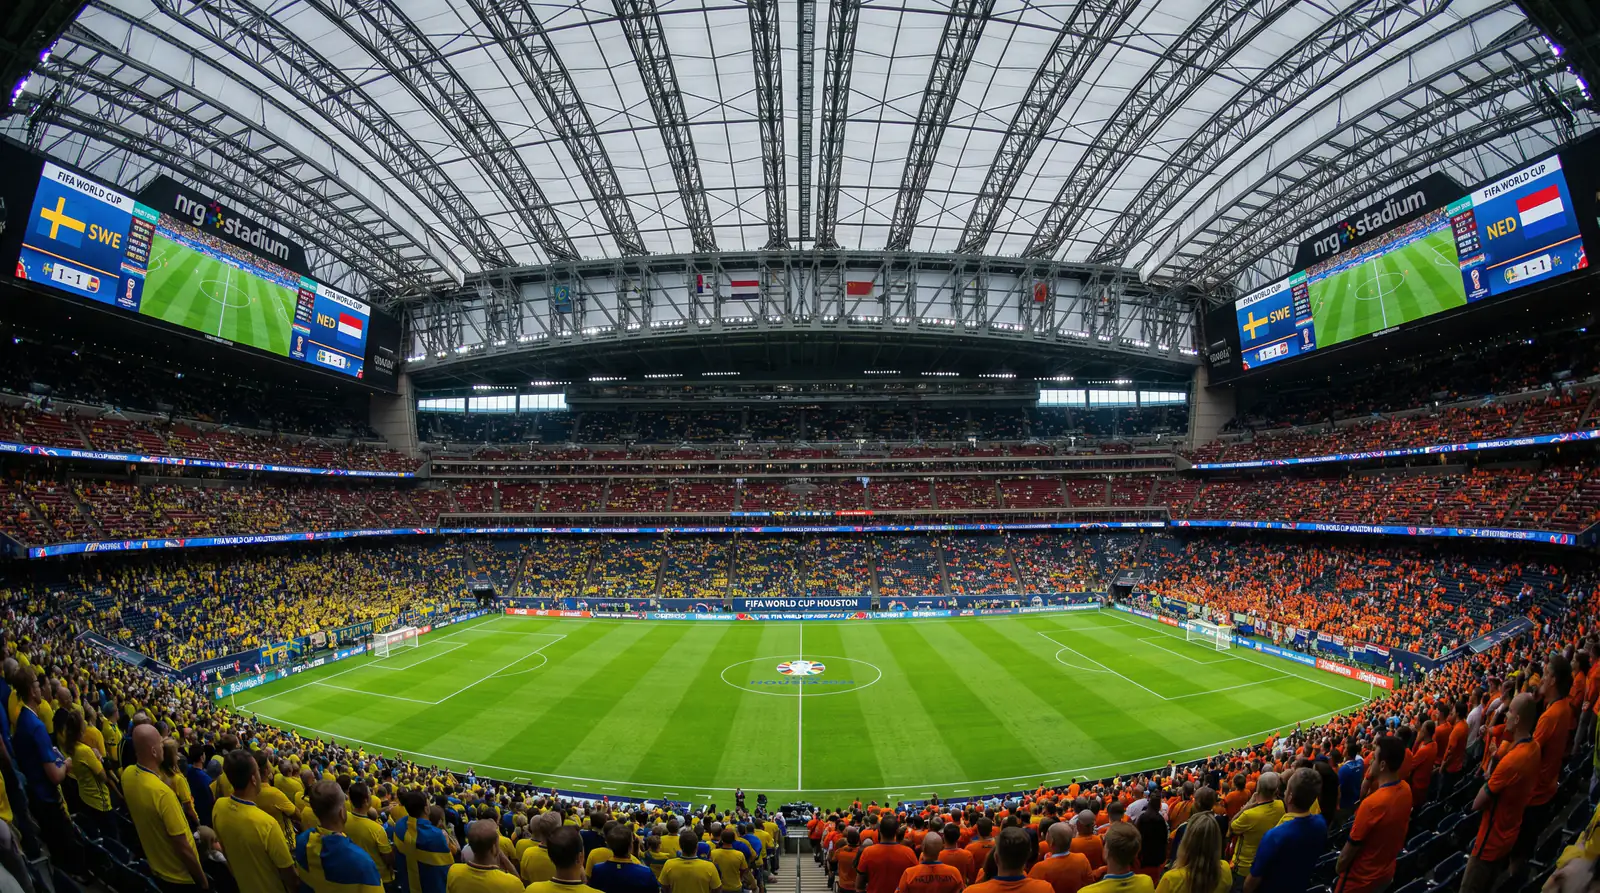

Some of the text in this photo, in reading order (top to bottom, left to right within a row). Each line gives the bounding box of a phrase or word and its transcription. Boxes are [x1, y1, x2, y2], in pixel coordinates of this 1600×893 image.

[57, 172, 122, 205] FIFA WORLD CUP
[1484, 165, 1546, 198] FIFA WORLD CUP
[88, 223, 122, 249] SWE
[175, 194, 289, 260] nrg stadium
[1314, 232, 1340, 256] nrg
[1356, 191, 1427, 236] stadium
[1486, 217, 1516, 240] NED
[317, 312, 336, 328] NED
[1270, 306, 1290, 323] SWE
